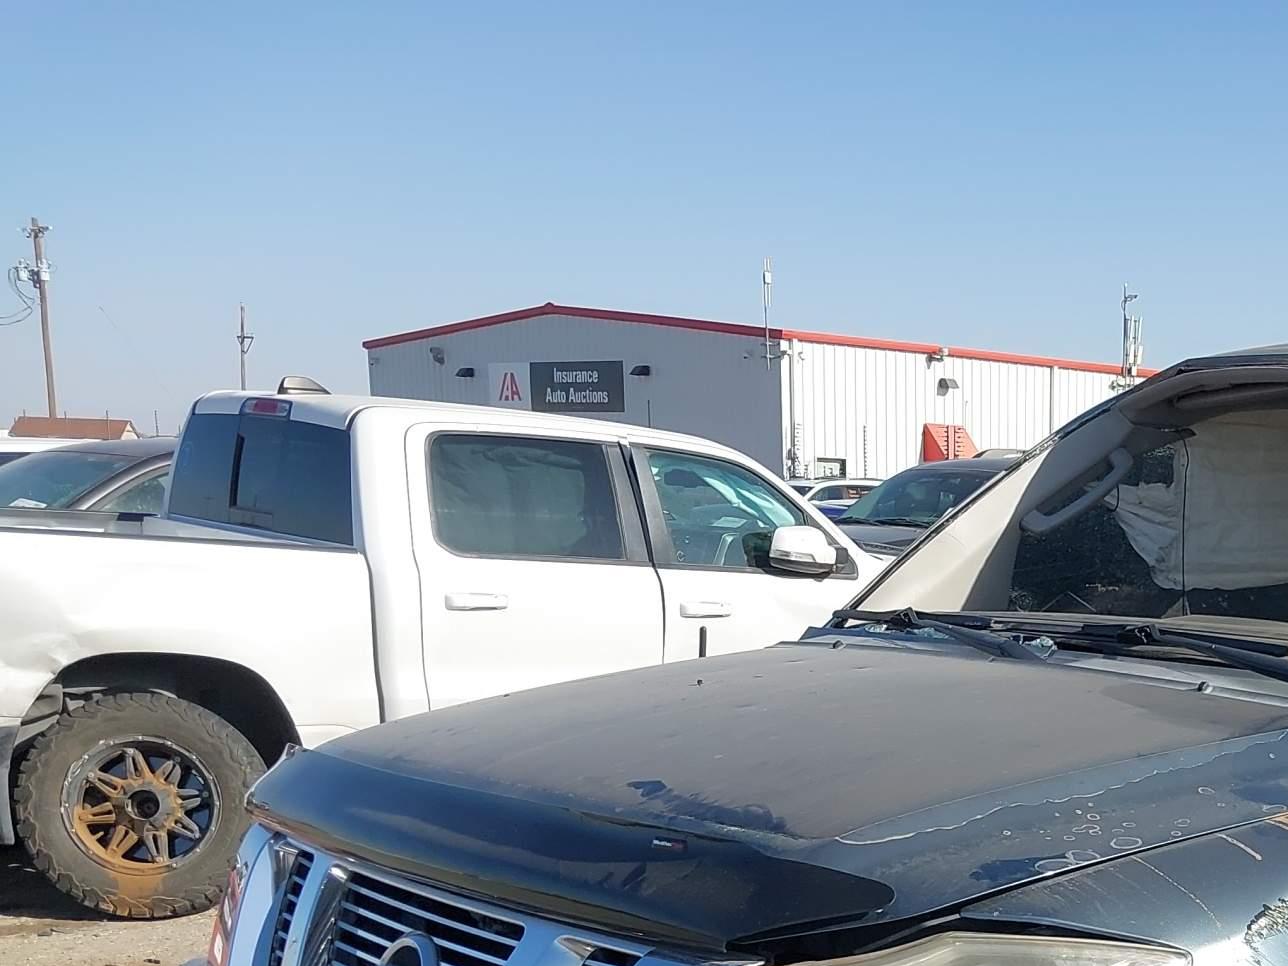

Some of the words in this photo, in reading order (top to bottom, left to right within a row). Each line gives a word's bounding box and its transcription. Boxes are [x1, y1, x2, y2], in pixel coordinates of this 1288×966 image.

[553, 367, 599, 384] Insurance
[545, 387, 567, 403] Auto
[568, 387, 609, 403] Auctions
